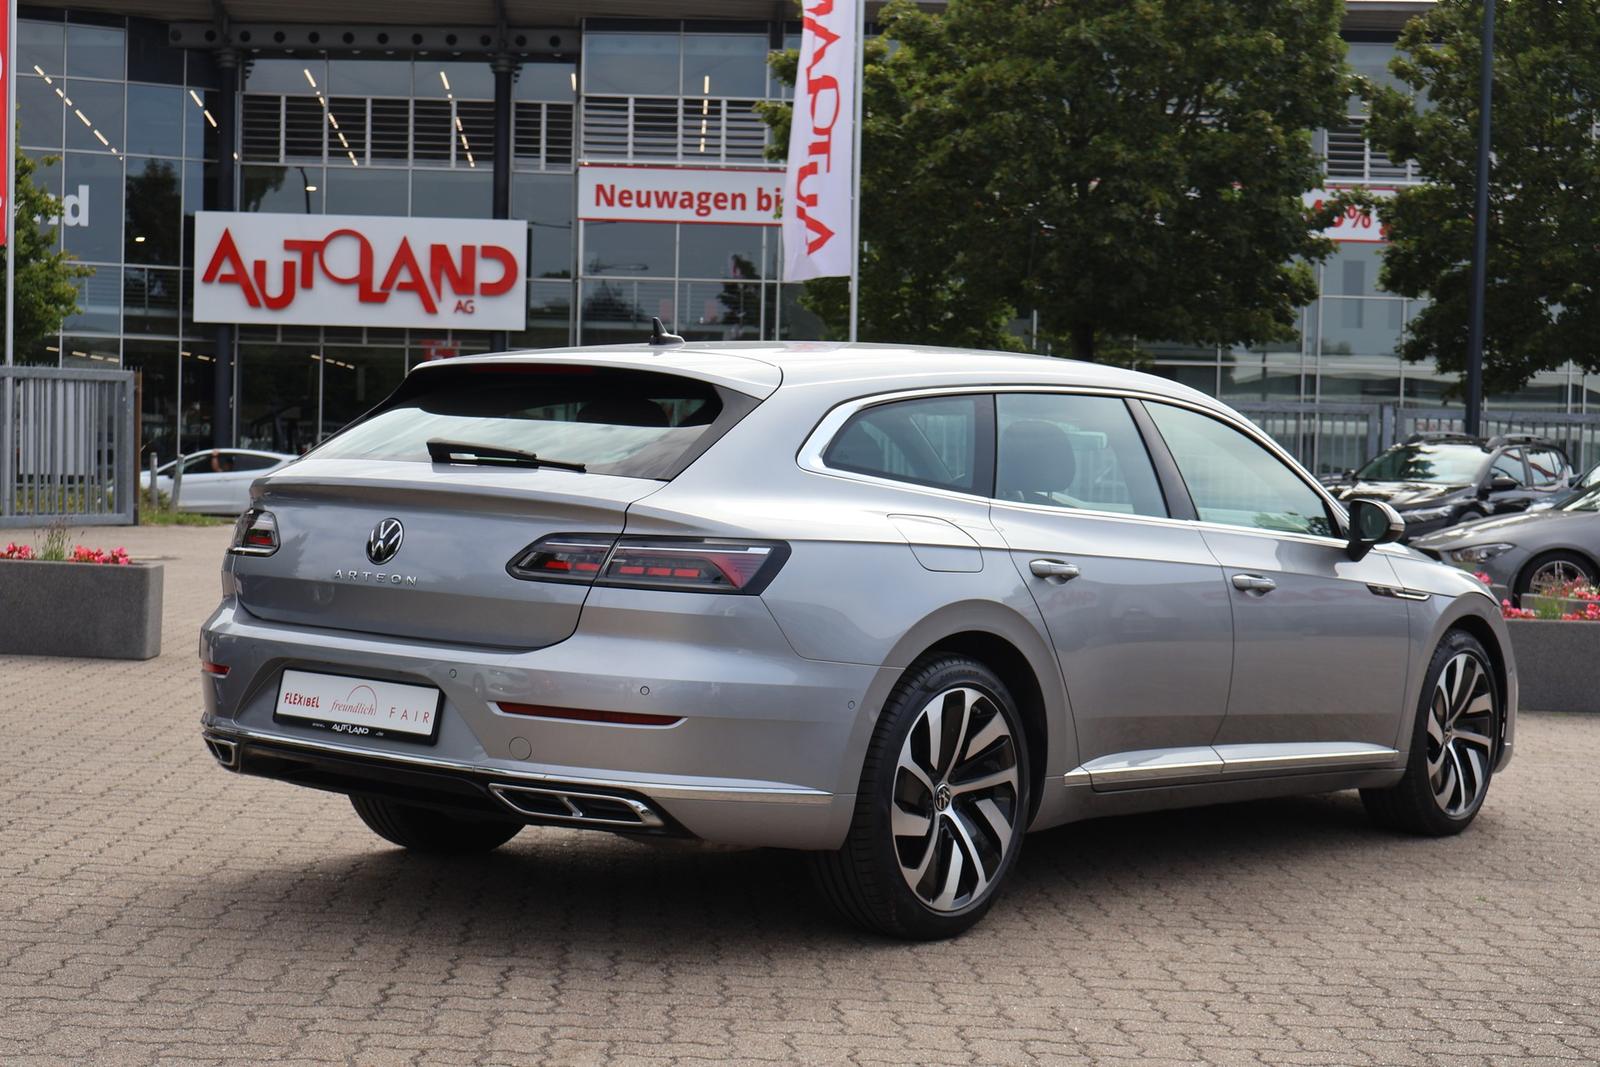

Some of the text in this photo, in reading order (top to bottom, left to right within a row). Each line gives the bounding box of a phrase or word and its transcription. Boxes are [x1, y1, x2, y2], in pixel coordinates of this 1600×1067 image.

[594, 183, 747, 217] Neuwagen
[202, 227, 519, 315] AUTOLAND
[454, 298, 475, 315] AG
[334, 568, 417, 586] ARTEON
[330, 699, 376, 715] freundlich
[389, 706, 430, 724] FAIR
